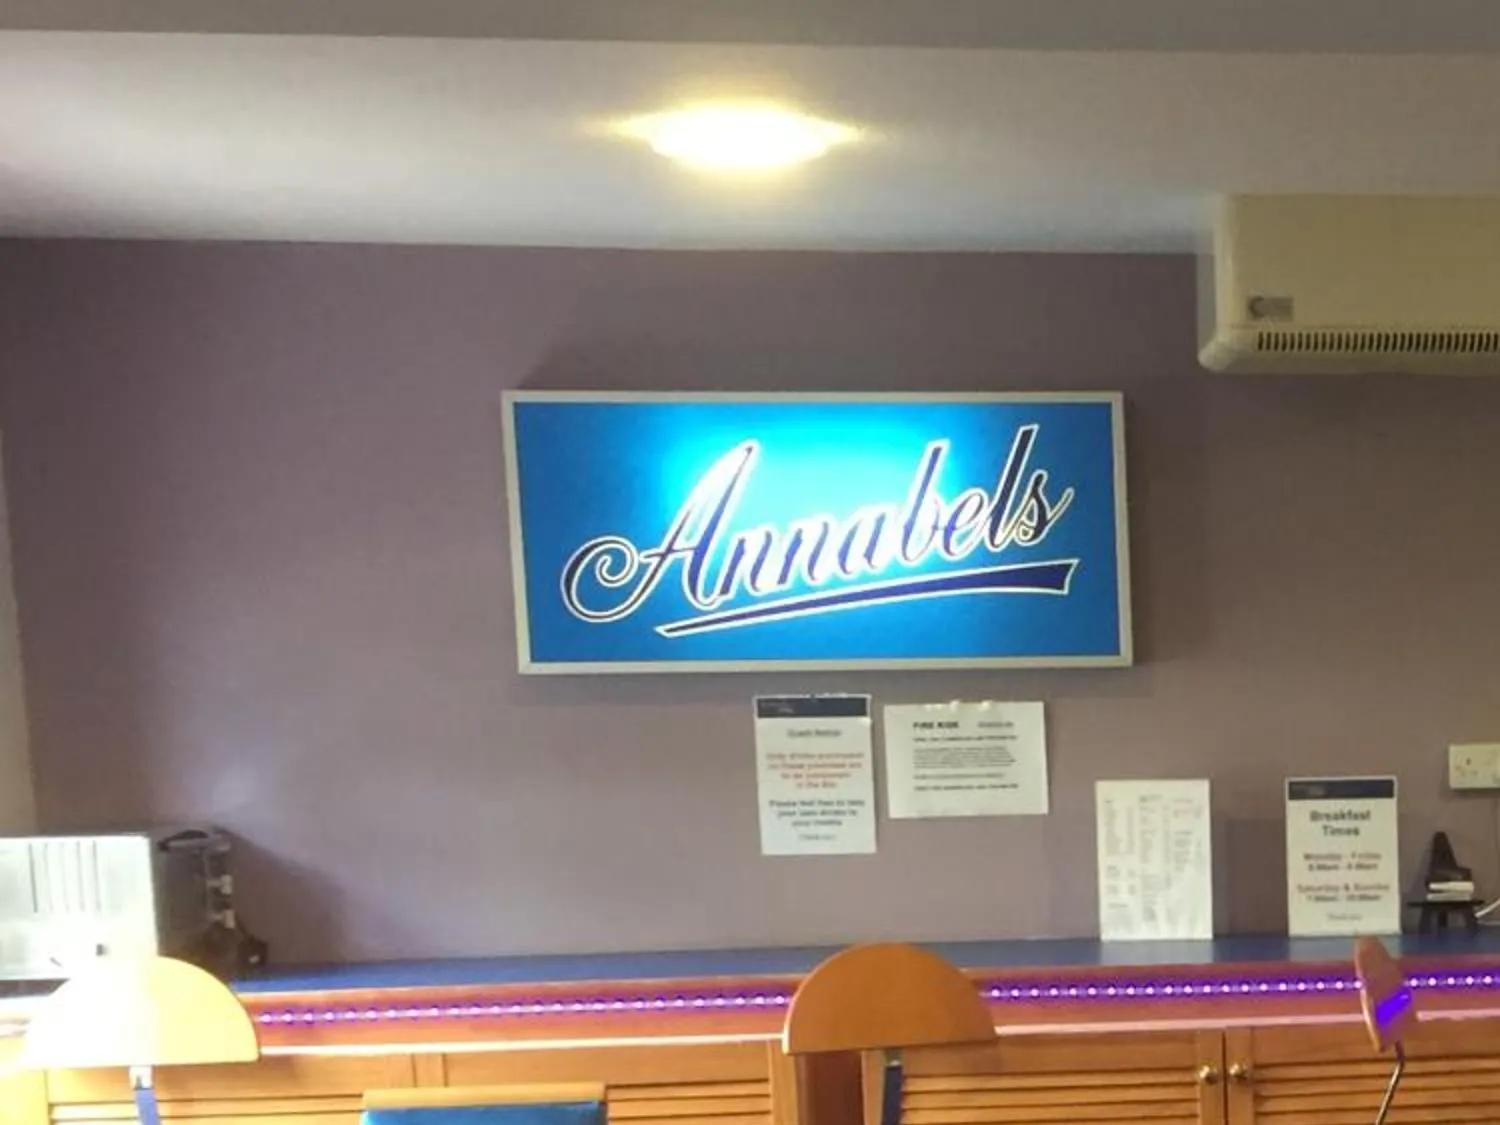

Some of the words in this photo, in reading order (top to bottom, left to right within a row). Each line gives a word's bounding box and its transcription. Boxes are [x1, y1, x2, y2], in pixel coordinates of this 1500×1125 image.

[560, 423, 1075, 624] Annabels
[1309, 810, 1372, 823] Breakfast
[1321, 824, 1361, 837] Times
